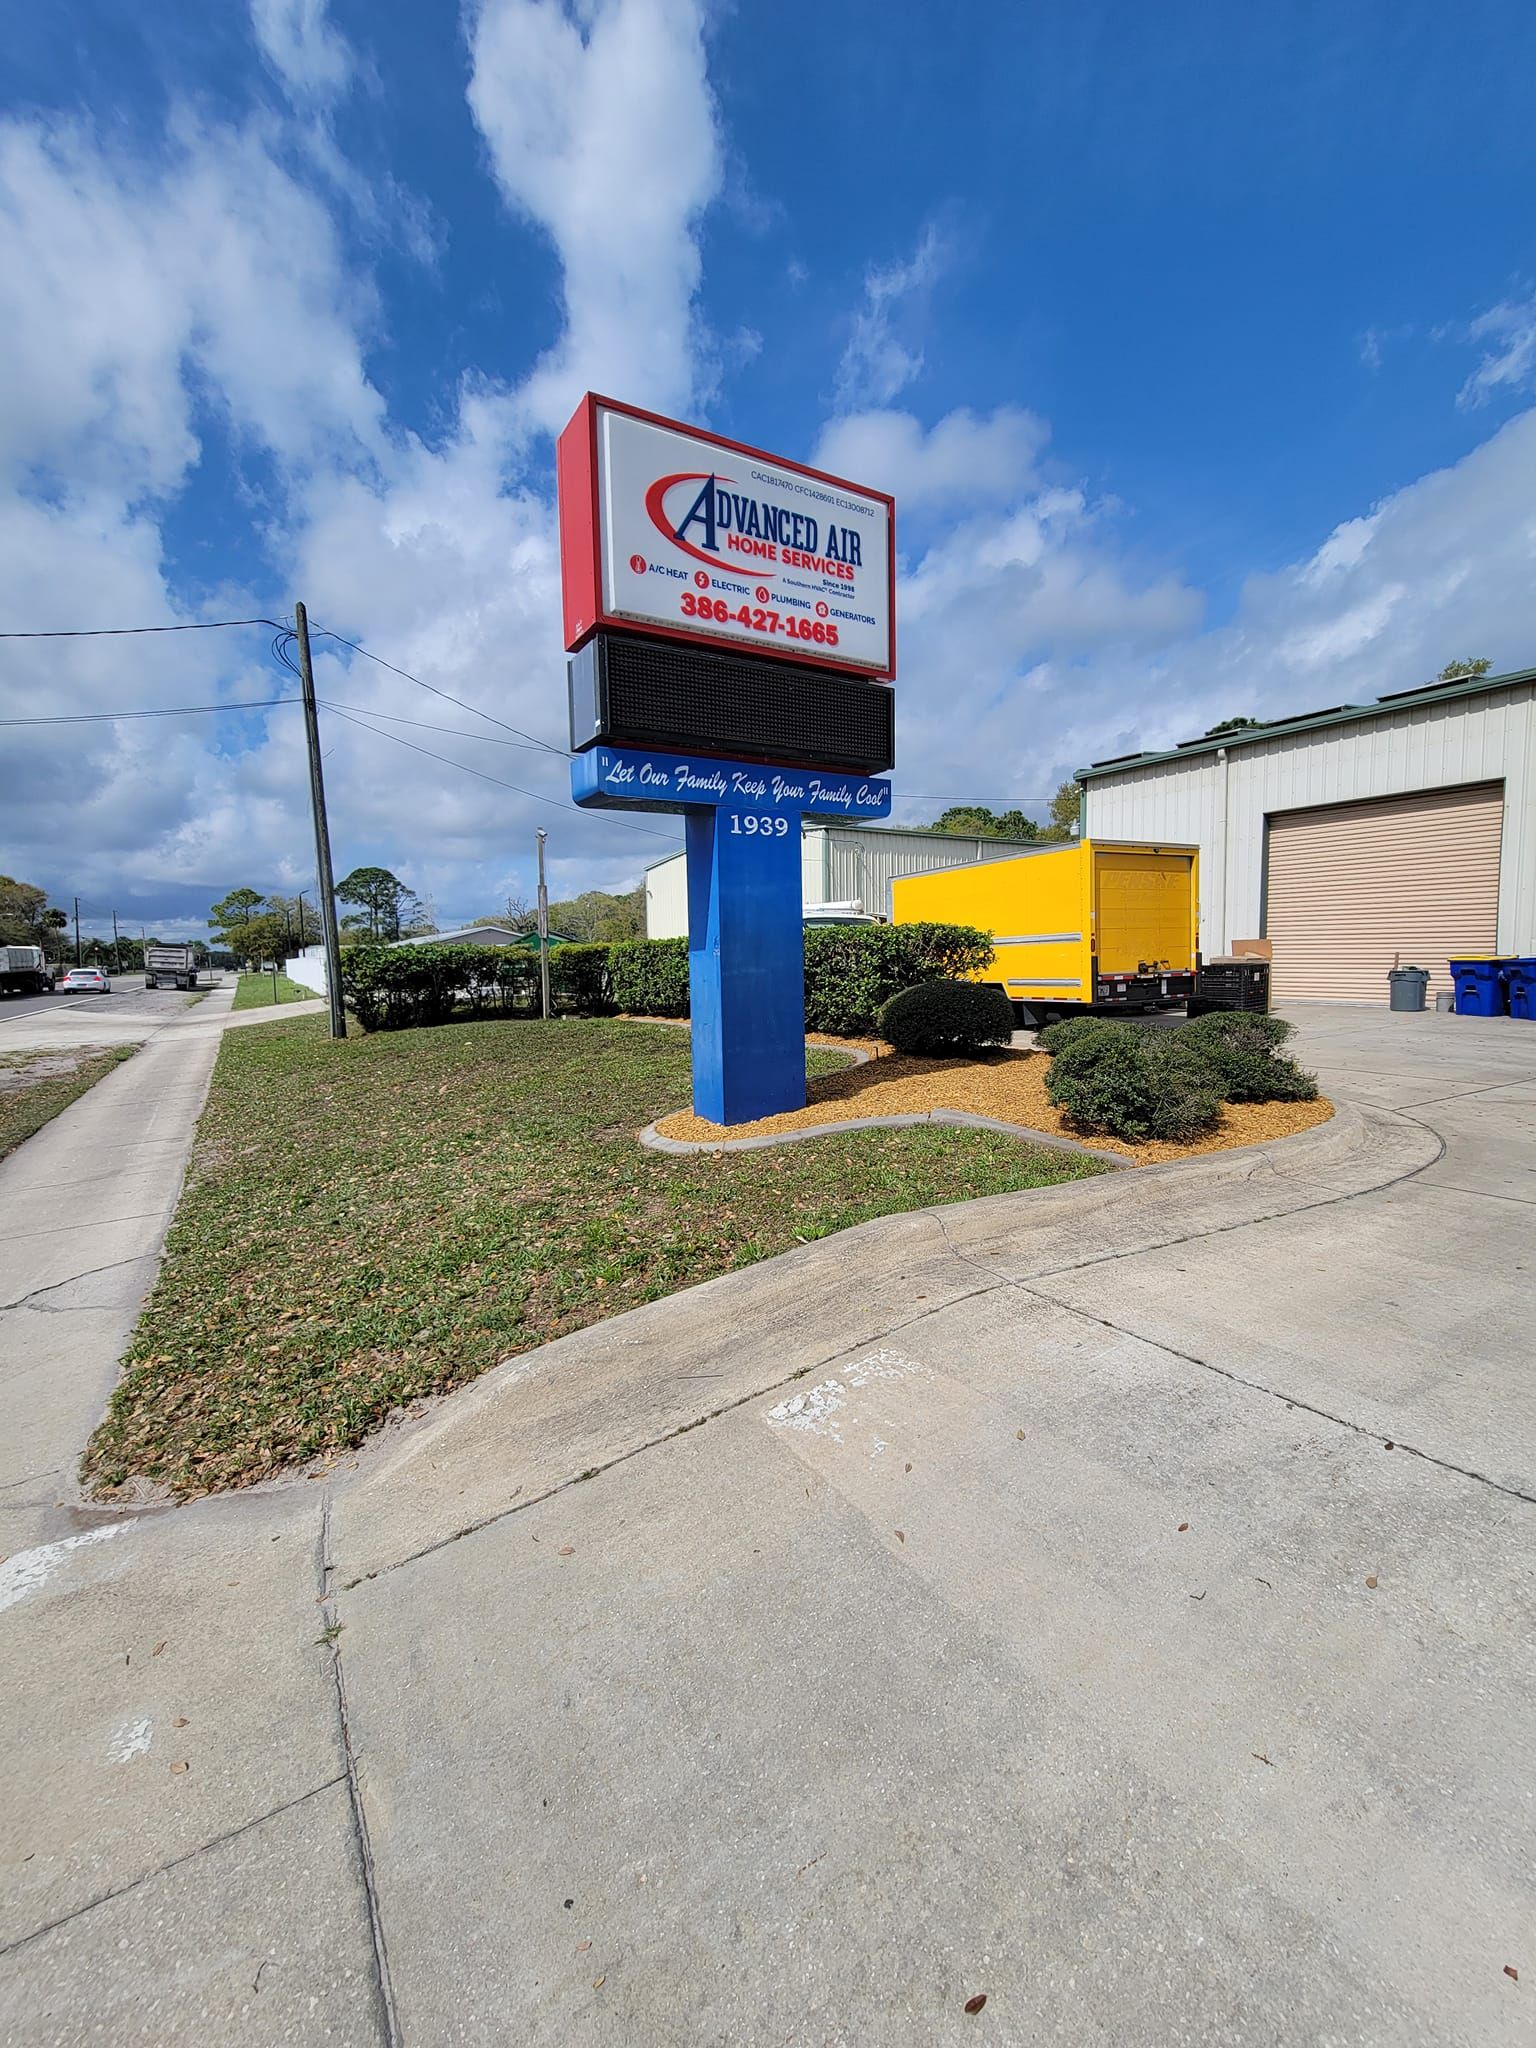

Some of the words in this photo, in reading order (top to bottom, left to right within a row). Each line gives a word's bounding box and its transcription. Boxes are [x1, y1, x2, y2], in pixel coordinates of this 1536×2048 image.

[751, 471, 793, 490] CAC1817470
[673, 472, 818, 553] ADVANCED
[825, 524, 862, 566] AIR
[727, 533, 777, 561] HOME
[781, 548, 854, 581] SERVICES
[649, 564, 665, 574] A/C
[666, 568, 688, 580] HEAT
[711, 579, 750, 595] ELECTRIC
[787, 578, 811, 589] Southern
[828, 588, 855, 600] Contractor
[822, 579, 839, 589] Since
[771, 593, 811, 609] PLUMBING
[680, 592, 839, 646] 386-427-1665
[830, 608, 876, 625] GENERATORS
[640, 763, 669, 786] Our
[674, 765, 728, 798] Family
[732, 772, 767, 800] Keep
[771, 775, 805, 803] Your
[809, 780, 852, 809] Family
[730, 814, 789, 837] 1939
